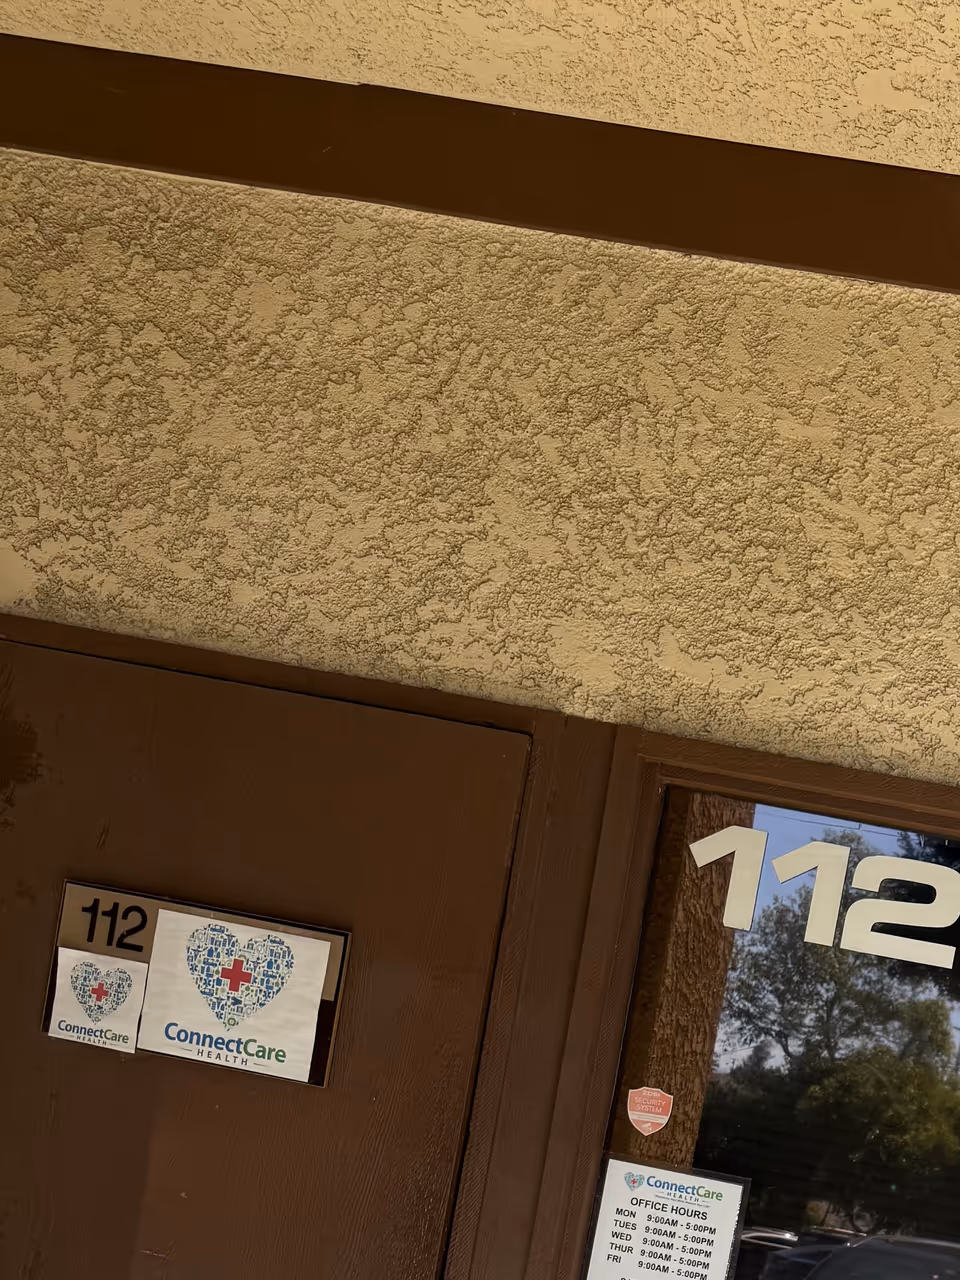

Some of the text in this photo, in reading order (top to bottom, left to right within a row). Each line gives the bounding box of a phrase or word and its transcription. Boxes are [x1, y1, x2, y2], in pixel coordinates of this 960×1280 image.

[81, 898, 148, 952] 112
[57, 1019, 130, 1044] ConnectCare
[76, 1035, 107, 1046] HEALTH
[164, 1022, 287, 1063] ConnectCare
[196, 1048, 248, 1066] HEALTH
[634, 1096, 666, 1107] SECURITY
[636, 1103, 662, 1113] SYSTEM
[646, 1175, 724, 1202] ConnectCare
[666, 1191, 700, 1203] HEALTH
[615, 1207, 637, 1218] MON
[646, 1214, 679, 1227] 9:00AM
[685, 1222, 717, 1236] 5:00PM
[630, 1197, 669, 1213] OFFICE
[670, 1205, 708, 1221] HOURS
[611, 1230, 632, 1242] WED
[642, 1237, 674, 1251] 9:00AM
[681, 1245, 712, 1259] 5:00PM
[613, 1219, 637, 1231] TUES
[644, 1225, 676, 1239] 9:00AM
[683, 1234, 714, 1247] 5:00PM
[606, 1253, 622, 1264] FRI
[638, 1260, 669, 1274] 9:00AM
[609, 1242, 634, 1254] THUR
[640, 1248, 672, 1262] 9:00AM
[678, 1257, 710, 1270] 5:00PM
